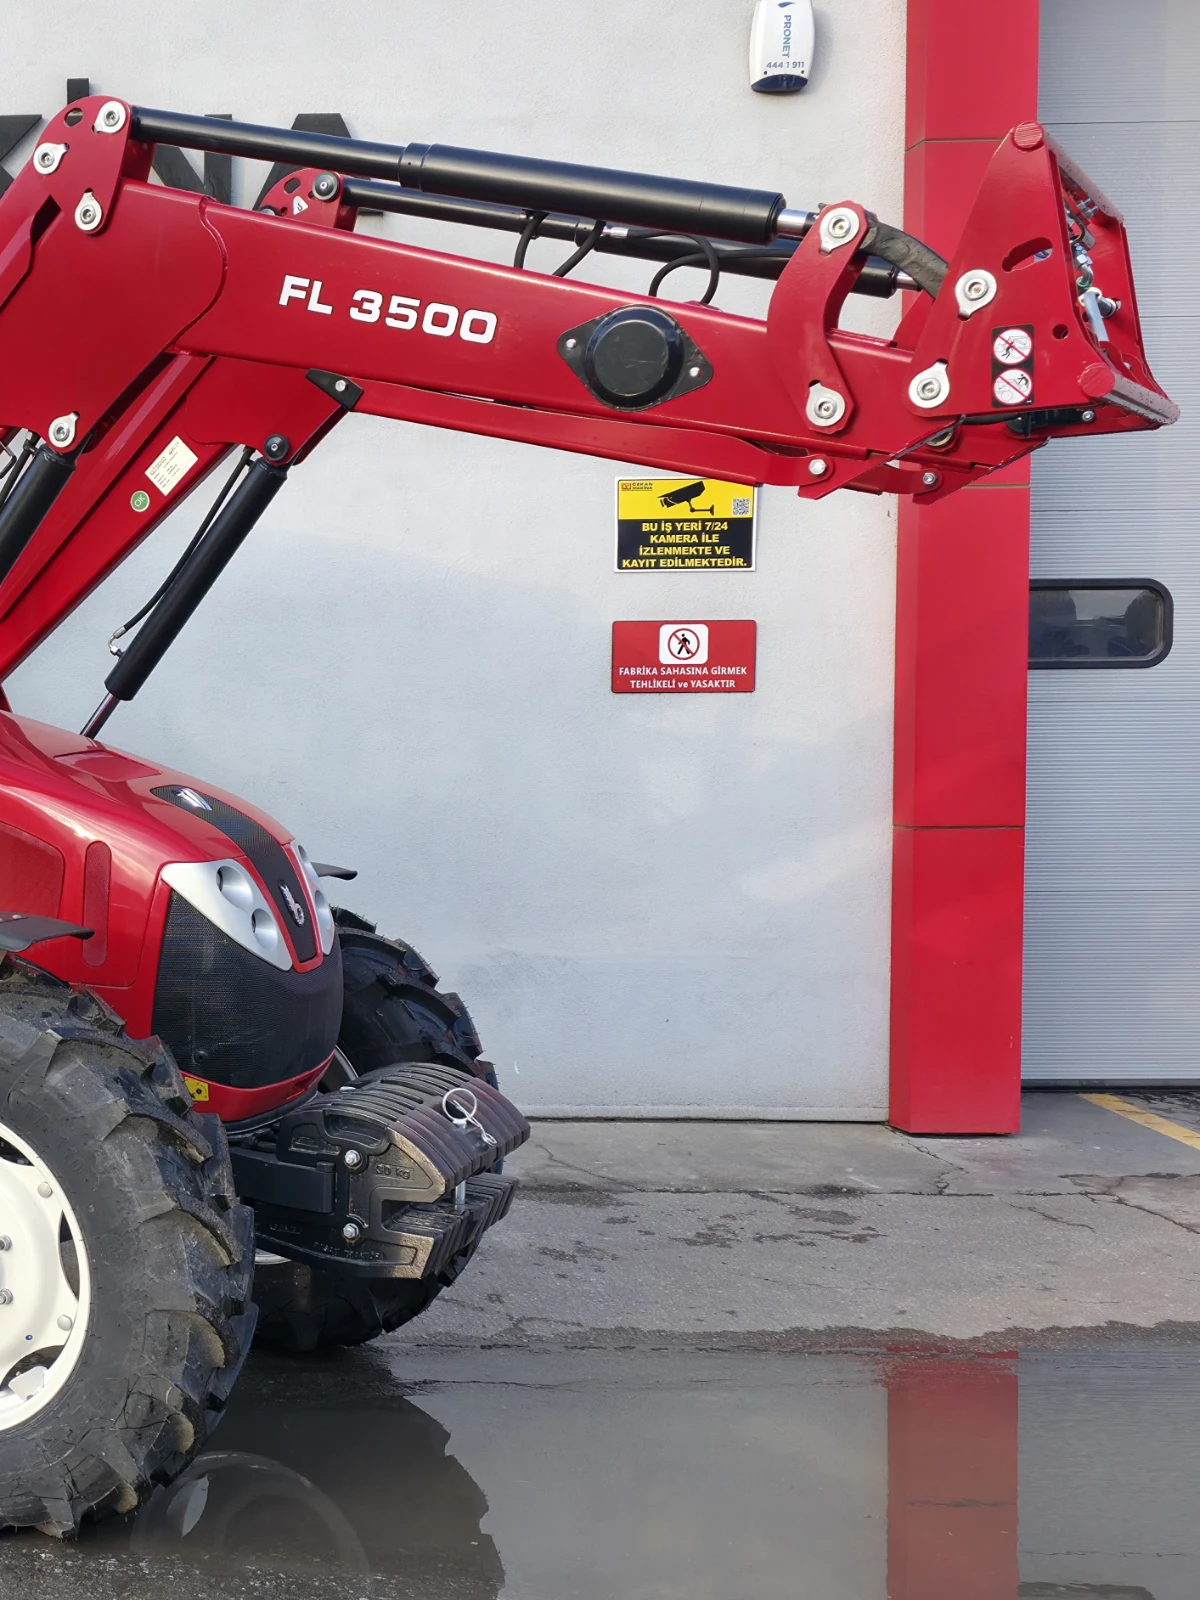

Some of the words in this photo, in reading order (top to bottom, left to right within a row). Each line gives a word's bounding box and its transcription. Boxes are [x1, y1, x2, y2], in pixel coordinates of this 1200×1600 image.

[782, 14, 792, 58] PRONET
[278, 274, 333, 315] FL
[349, 289, 498, 344] 3500
[642, 522, 658, 532] BU
[661, 521, 672, 533] İŞ
[676, 520, 702, 531] YERİ
[705, 522, 728, 531] 7/24
[650, 534, 698, 543] KAMERA
[702, 532, 720, 542] İLE
[639, 546, 712, 556] İZLENMEKTE
[715, 546, 730, 554] VE
[622, 559, 656, 567] KAYIT
[660, 556, 747, 567] EDİLMEKTEDİR.
[619, 665, 658, 675] FABRİKA
[660, 667, 708, 675] SAHASINA
[711, 666, 747, 675] GİRMEK
[630, 678, 675, 688] TEHLİKELİ
[691, 680, 736, 688] YASAKTIR
